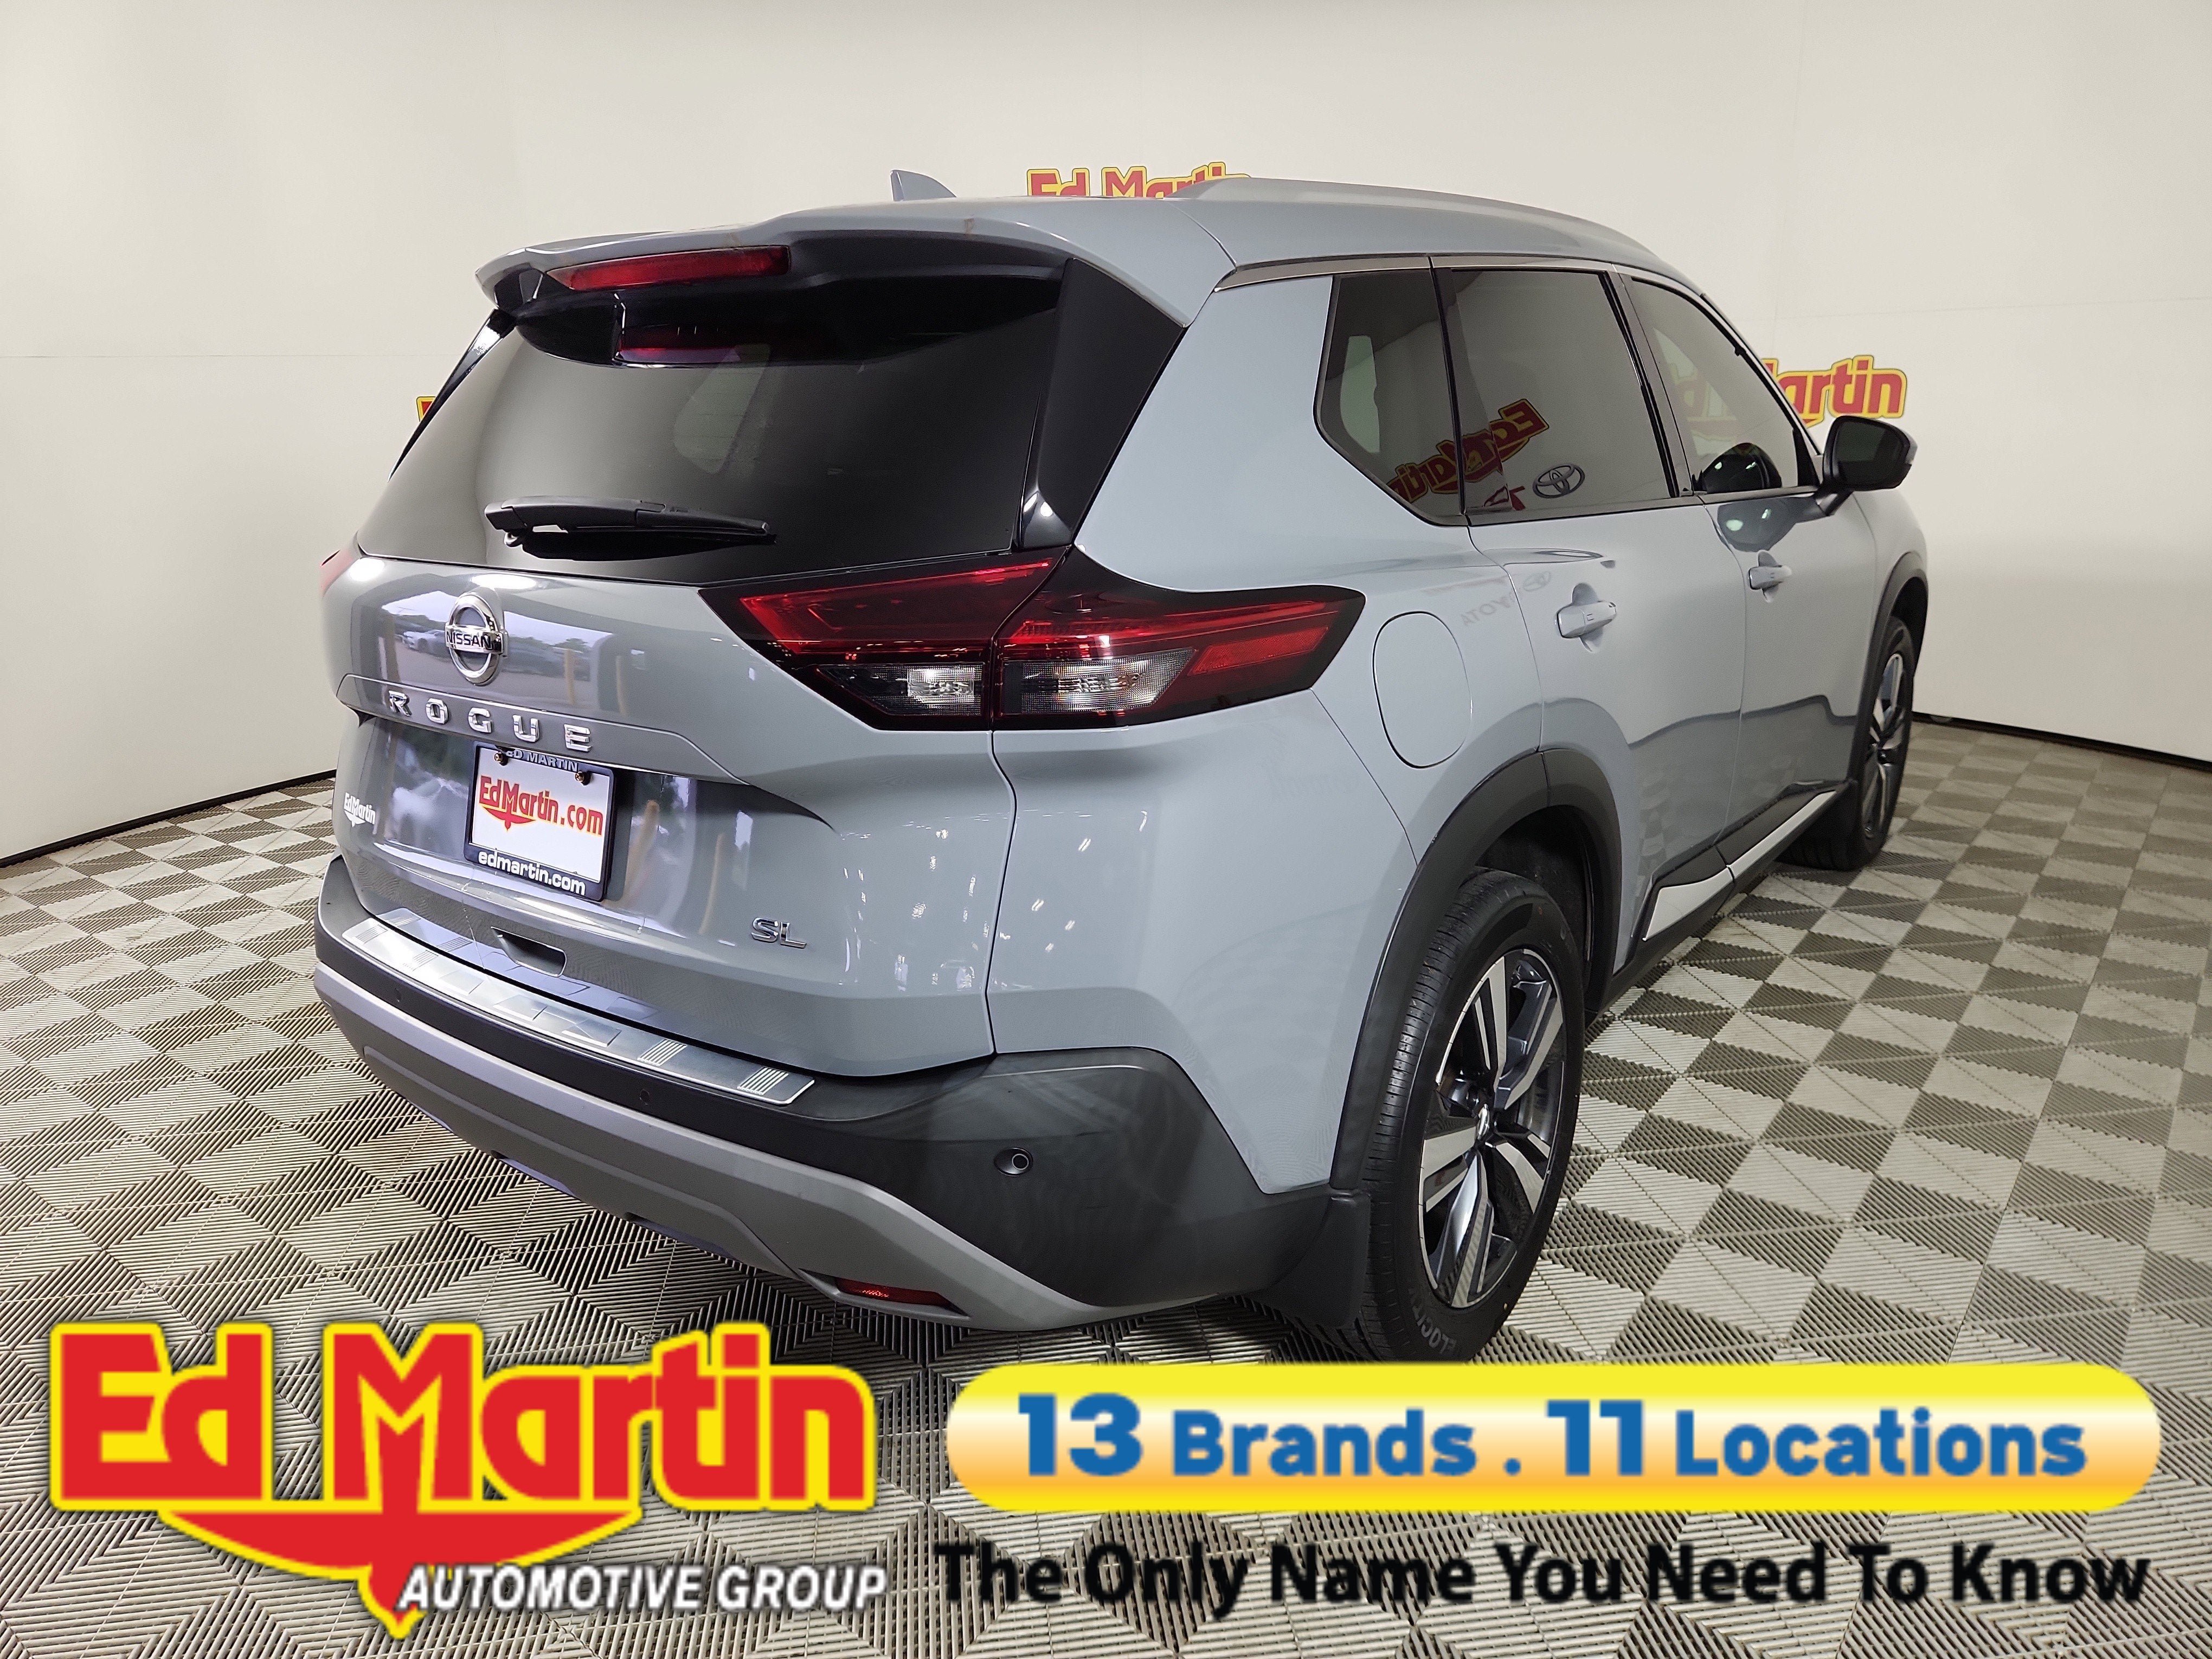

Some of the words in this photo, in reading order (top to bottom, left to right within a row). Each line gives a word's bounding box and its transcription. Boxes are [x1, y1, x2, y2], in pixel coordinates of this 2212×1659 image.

[1763, 356, 1906, 417] artin
[446, 631, 492, 650] NISSAN
[388, 690, 593, 752] ROGUE
[526, 751, 579, 772] MARTIN
[344, 792, 376, 825] EdMartin
[478, 851, 586, 896] edmartin.com
[751, 917, 807, 949] SL
